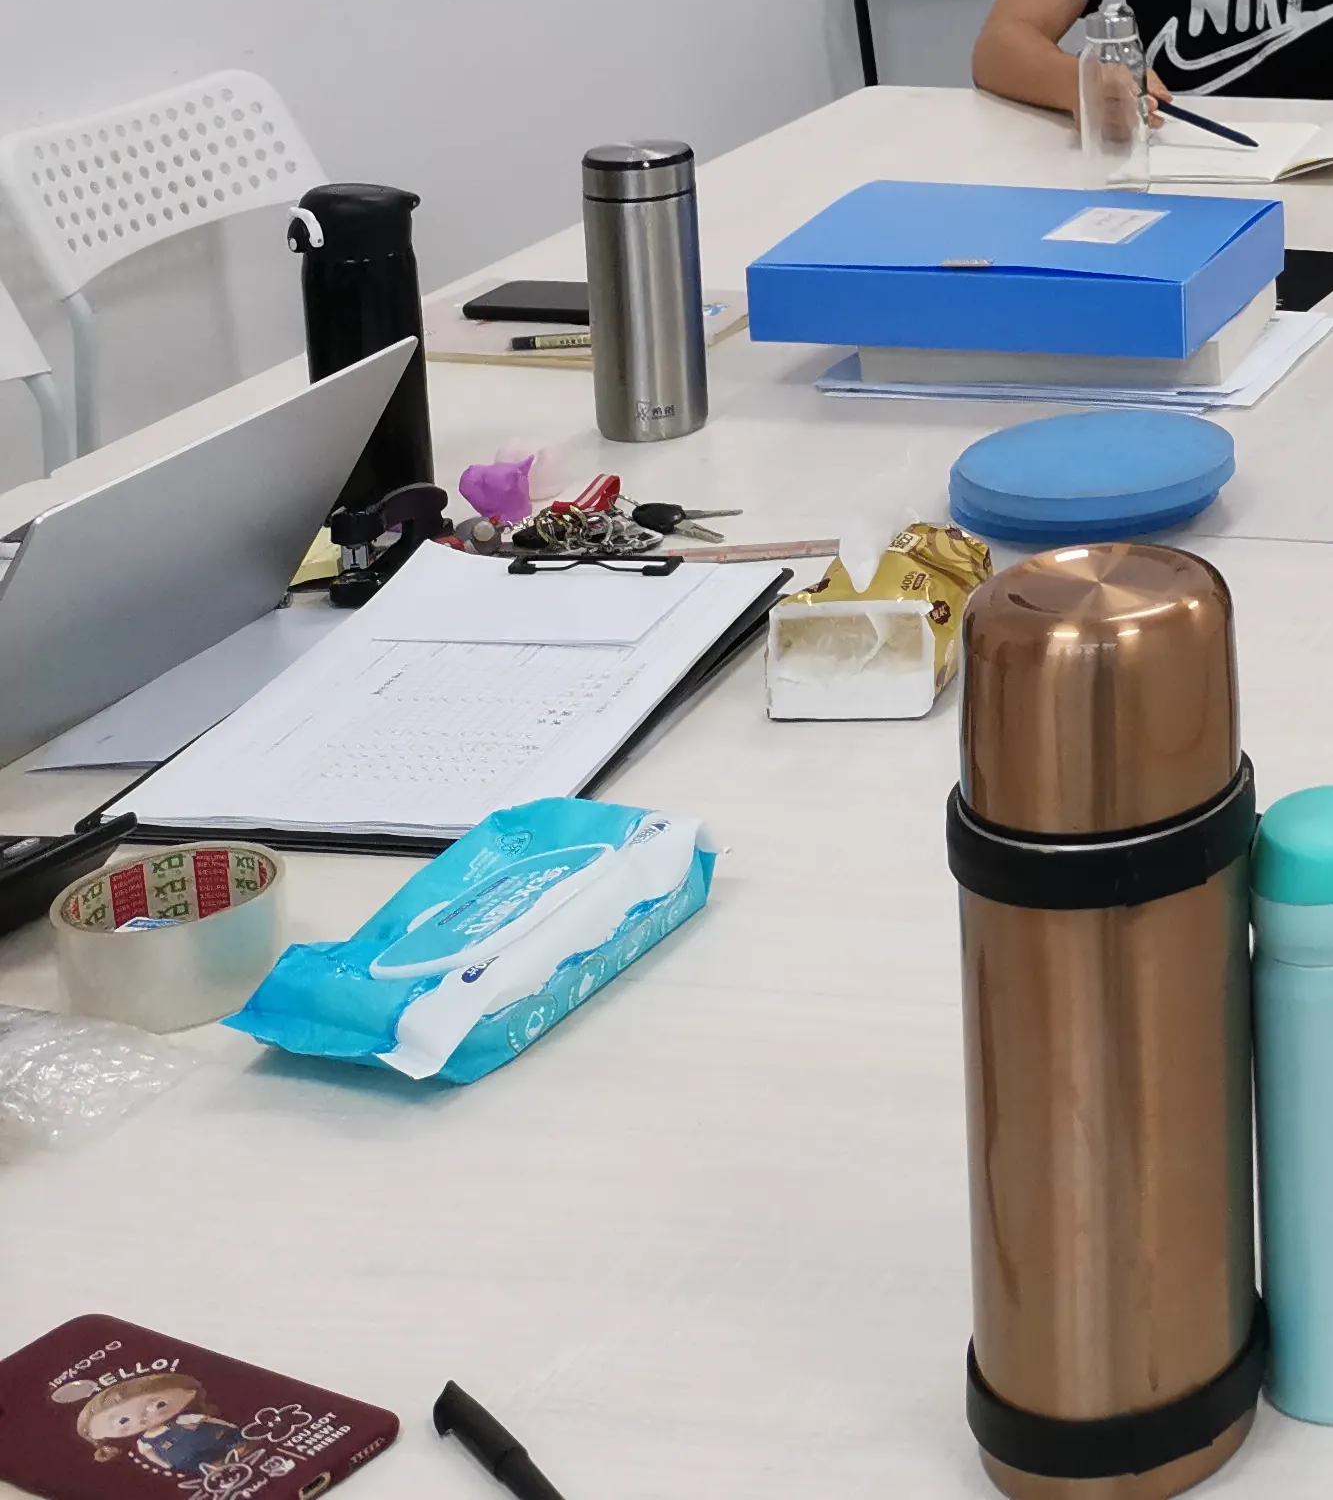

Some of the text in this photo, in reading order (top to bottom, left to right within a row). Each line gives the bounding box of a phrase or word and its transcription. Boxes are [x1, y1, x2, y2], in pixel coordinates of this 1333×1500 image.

[93, 1358, 180, 1392] ELLO!
[283, 1411, 337, 1447] YOU GOT
[295, 1424, 335, 1453] A NEW
[306, 1425, 352, 1456] FRIEND
